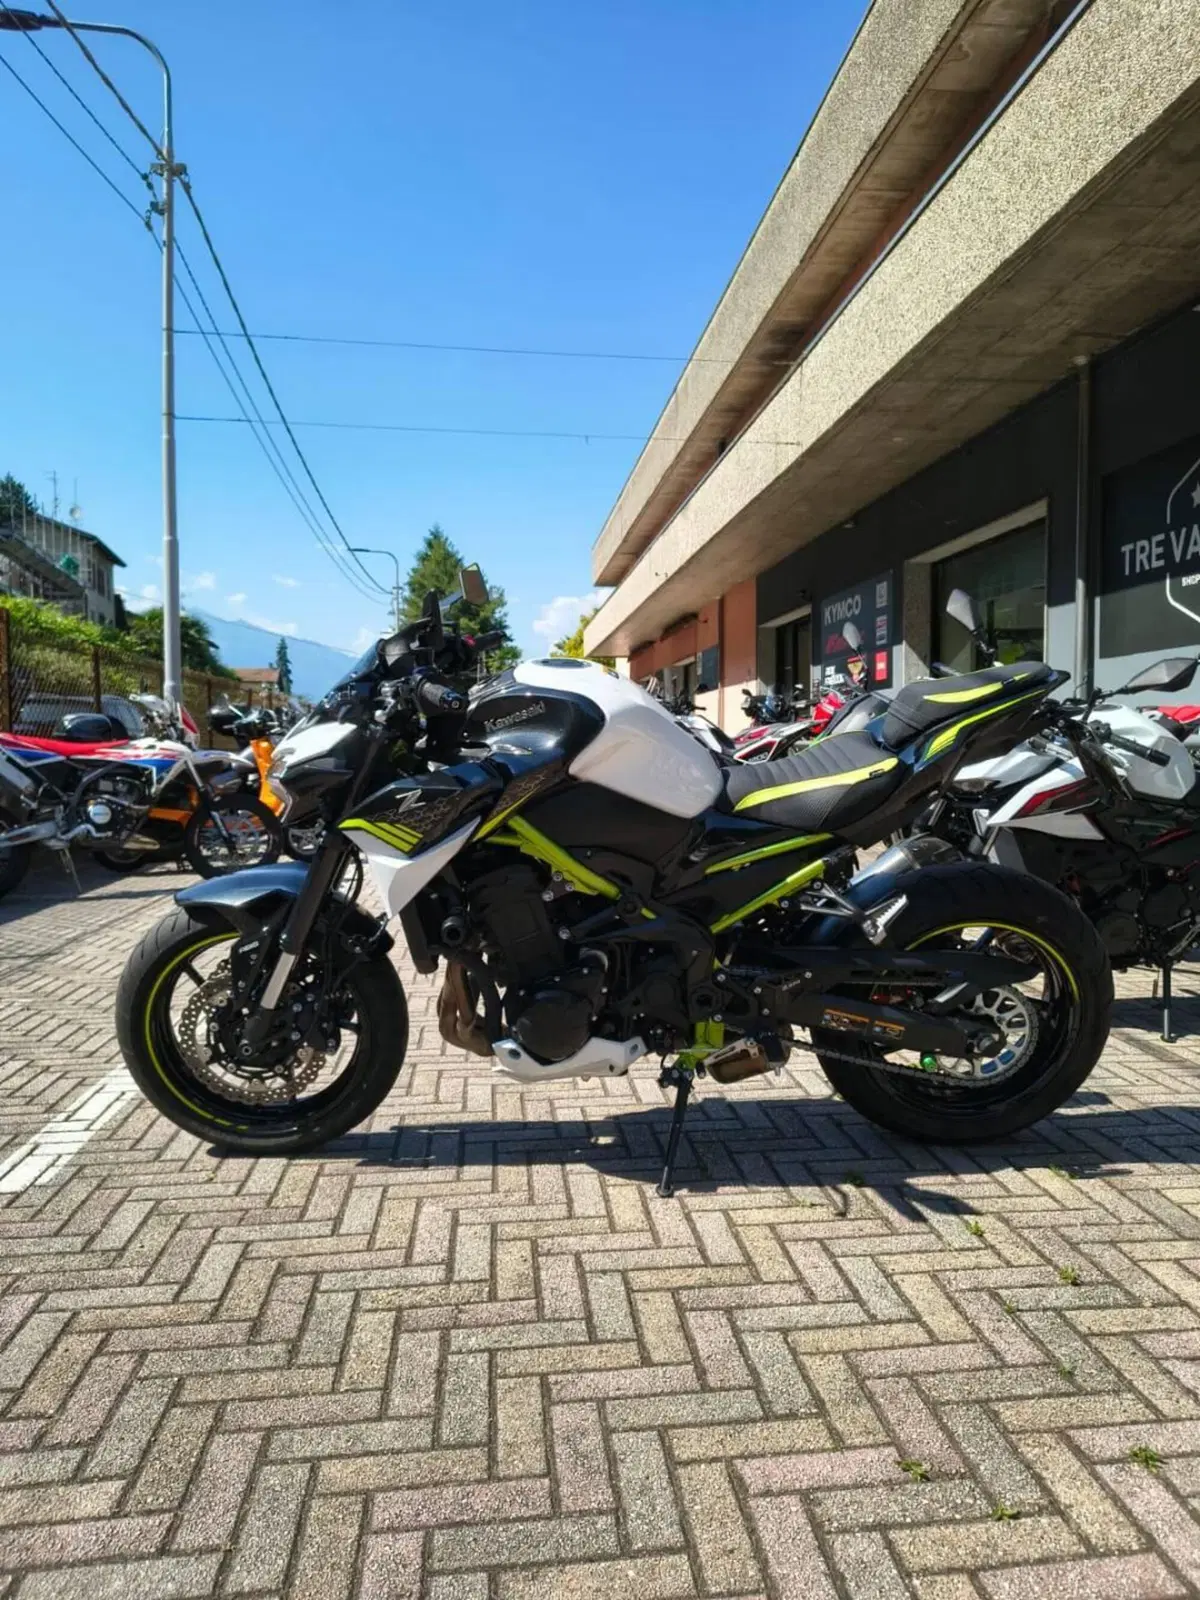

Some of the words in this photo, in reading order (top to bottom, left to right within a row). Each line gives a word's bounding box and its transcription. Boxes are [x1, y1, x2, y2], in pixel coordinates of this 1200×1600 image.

[1121, 533, 1165, 576] TRE
[824, 595, 861, 626] KYMCO
[484, 701, 546, 732] Kawasaki
